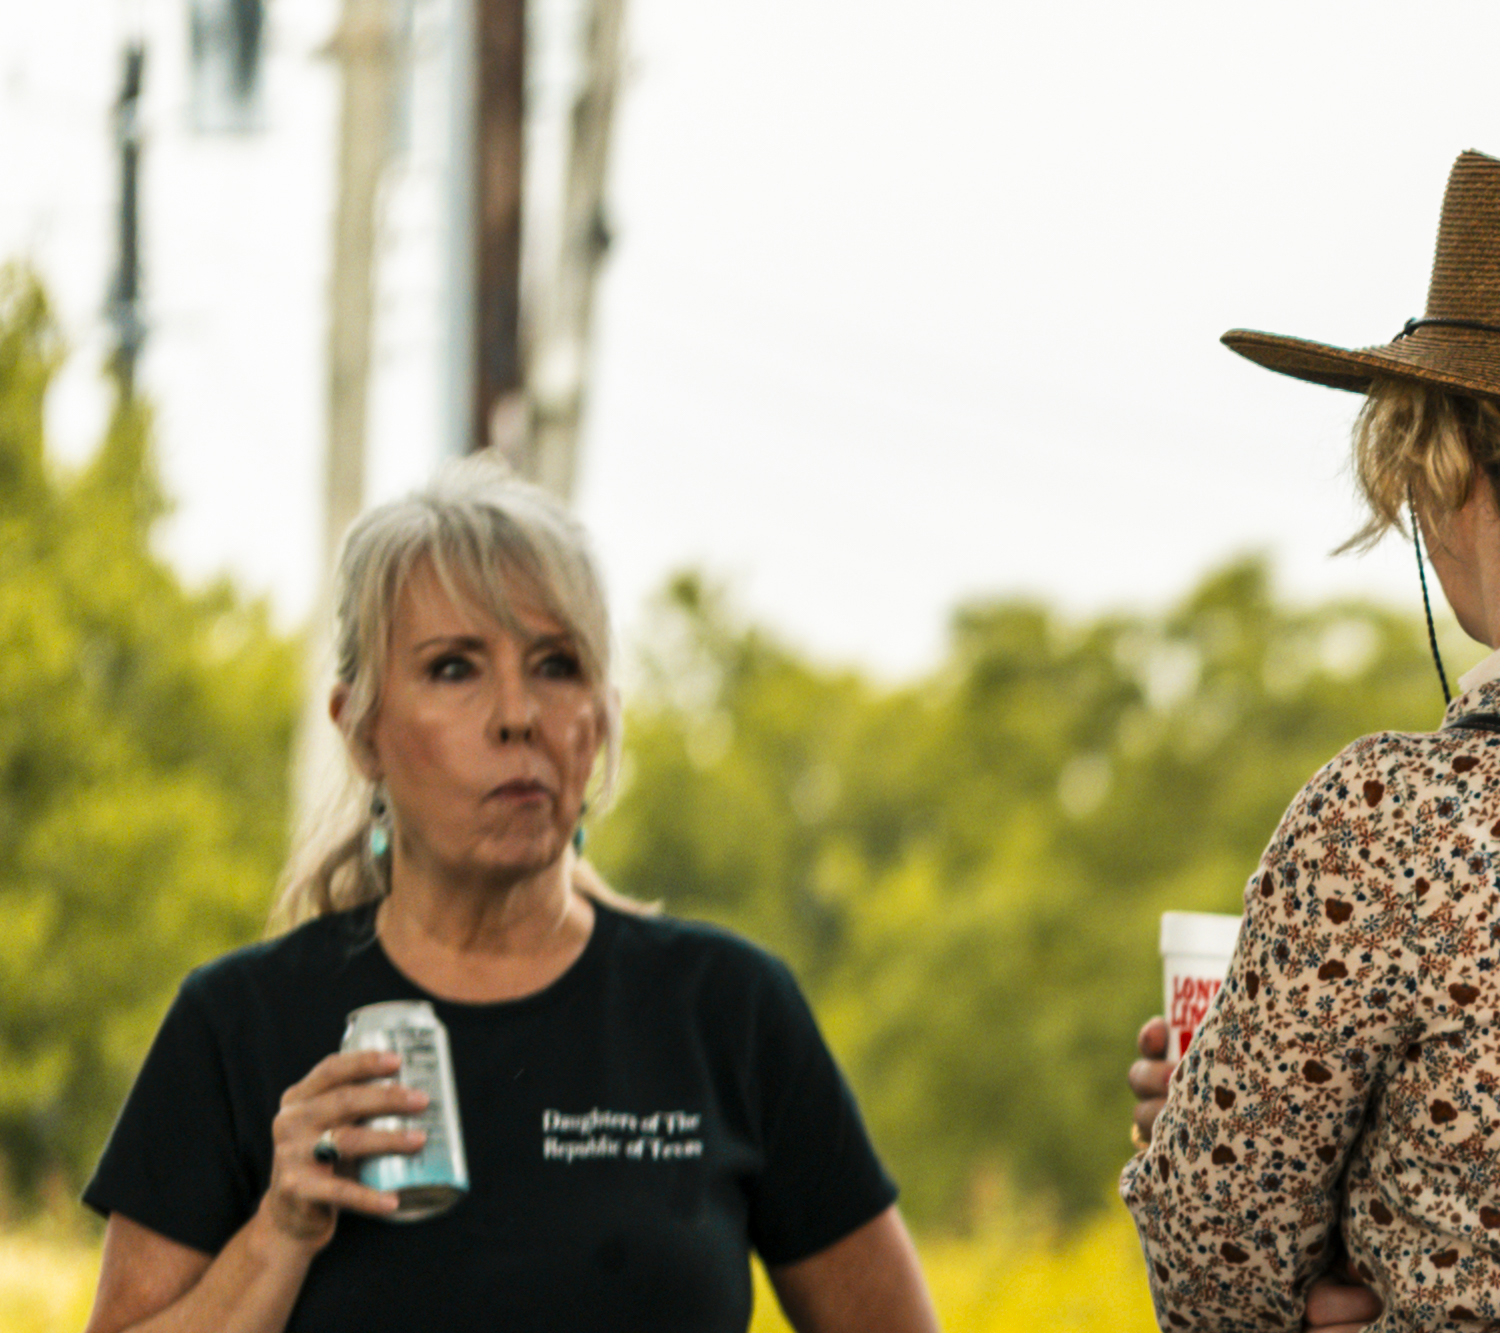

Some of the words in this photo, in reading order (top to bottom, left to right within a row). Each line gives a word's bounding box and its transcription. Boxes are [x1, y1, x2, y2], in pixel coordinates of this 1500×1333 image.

[542, 1106, 638, 1135] Daughters
[639, 1111, 660, 1135] of
[662, 1109, 702, 1135] The
[543, 1133, 622, 1164] Republic
[624, 1138, 646, 1160] of
[649, 1137, 704, 1161] Texas
